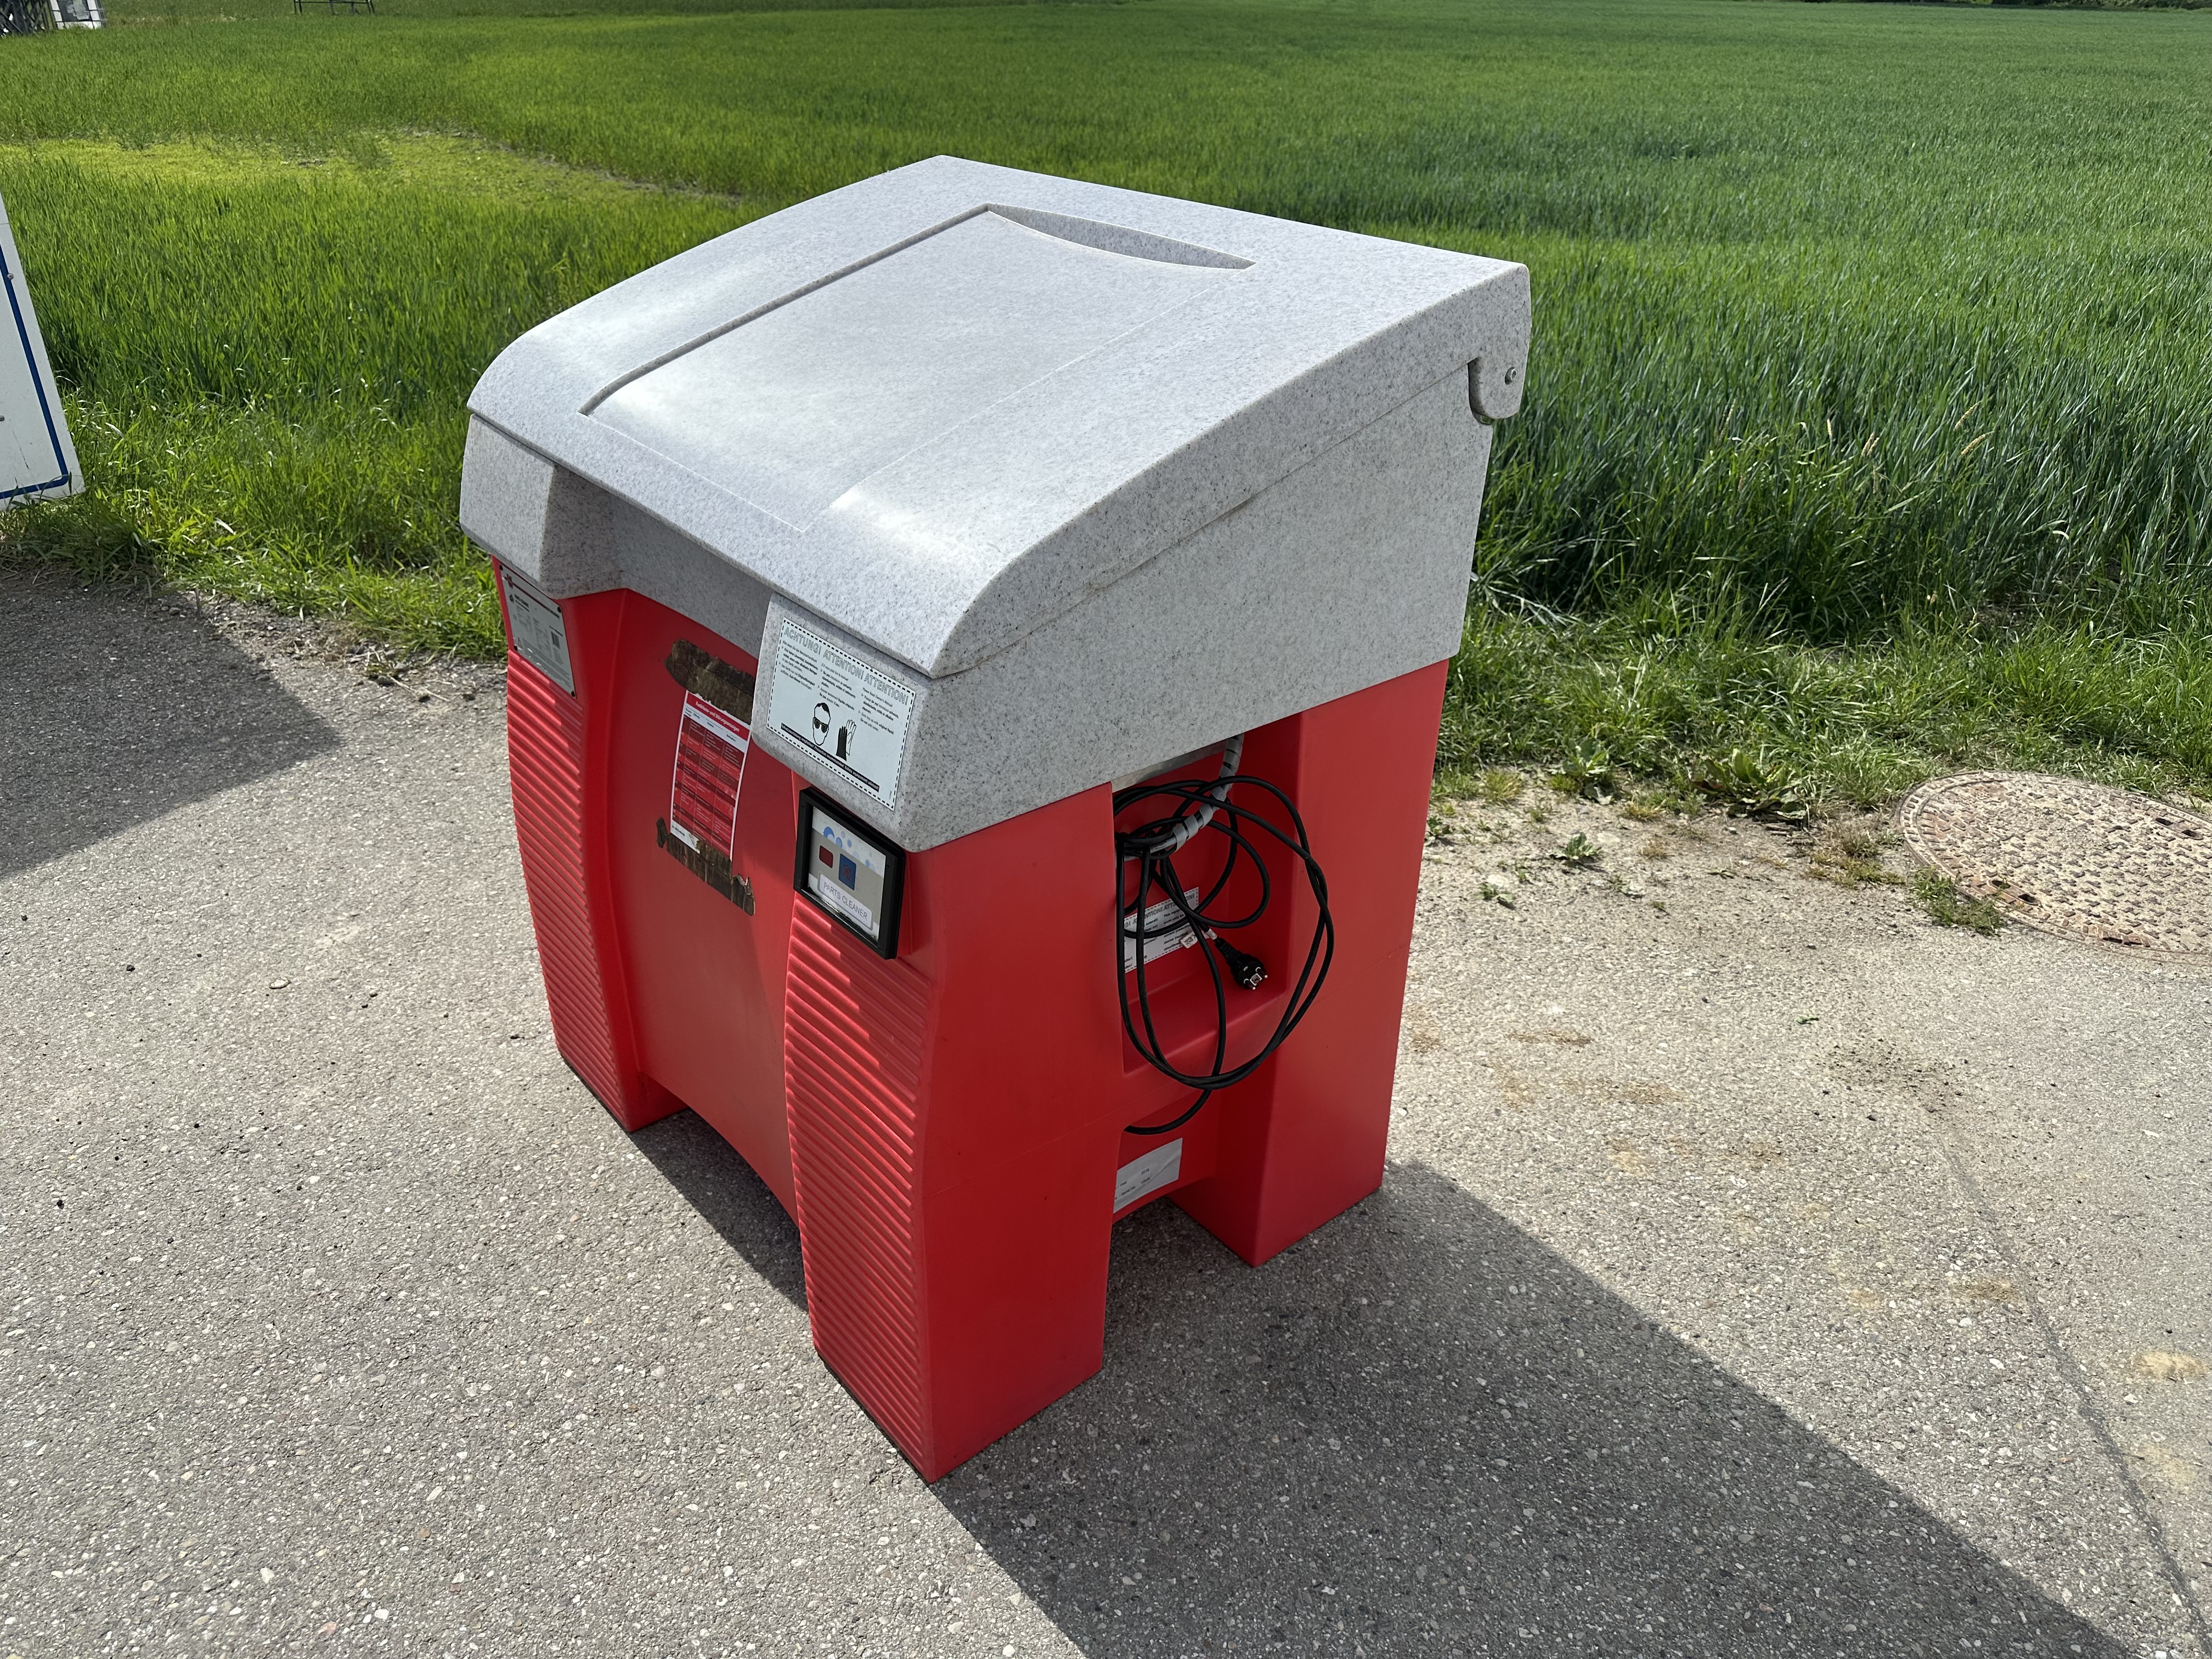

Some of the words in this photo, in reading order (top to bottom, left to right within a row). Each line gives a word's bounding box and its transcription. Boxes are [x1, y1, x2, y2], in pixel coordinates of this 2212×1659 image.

[784, 627, 821, 654] ACHTUNG!
[823, 649, 864, 679] ATTENTION!
[864, 673, 909, 706] ATTENTION!
[824, 882, 840, 900] PARTS
[842, 896, 867, 920] CLEANER
